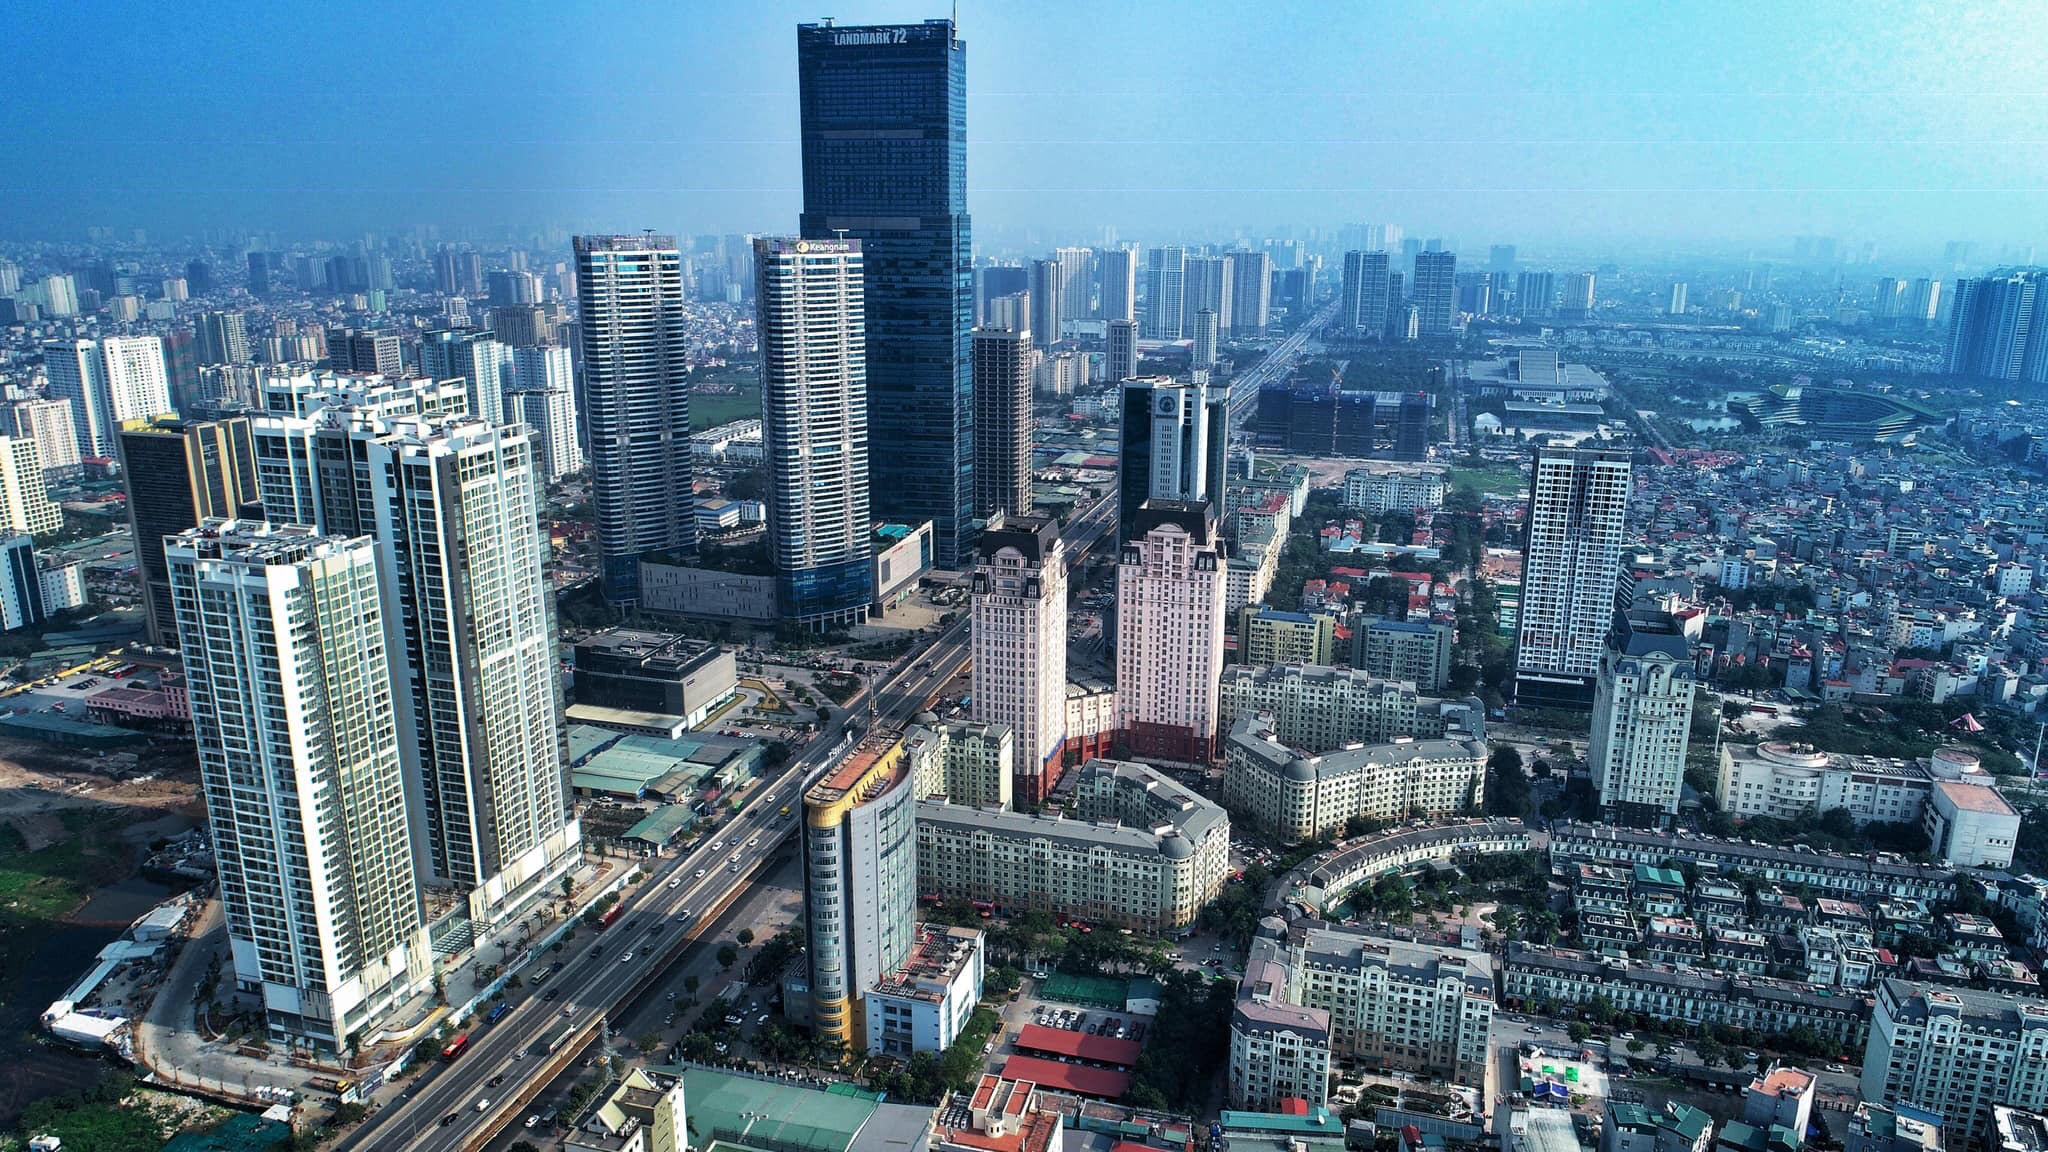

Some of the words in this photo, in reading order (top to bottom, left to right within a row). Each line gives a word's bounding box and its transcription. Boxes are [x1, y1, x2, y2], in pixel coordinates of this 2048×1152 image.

[834, 32, 890, 45] LANDMARK
[892, 27, 907, 43] 72
[810, 243, 849, 254] Keangnam
